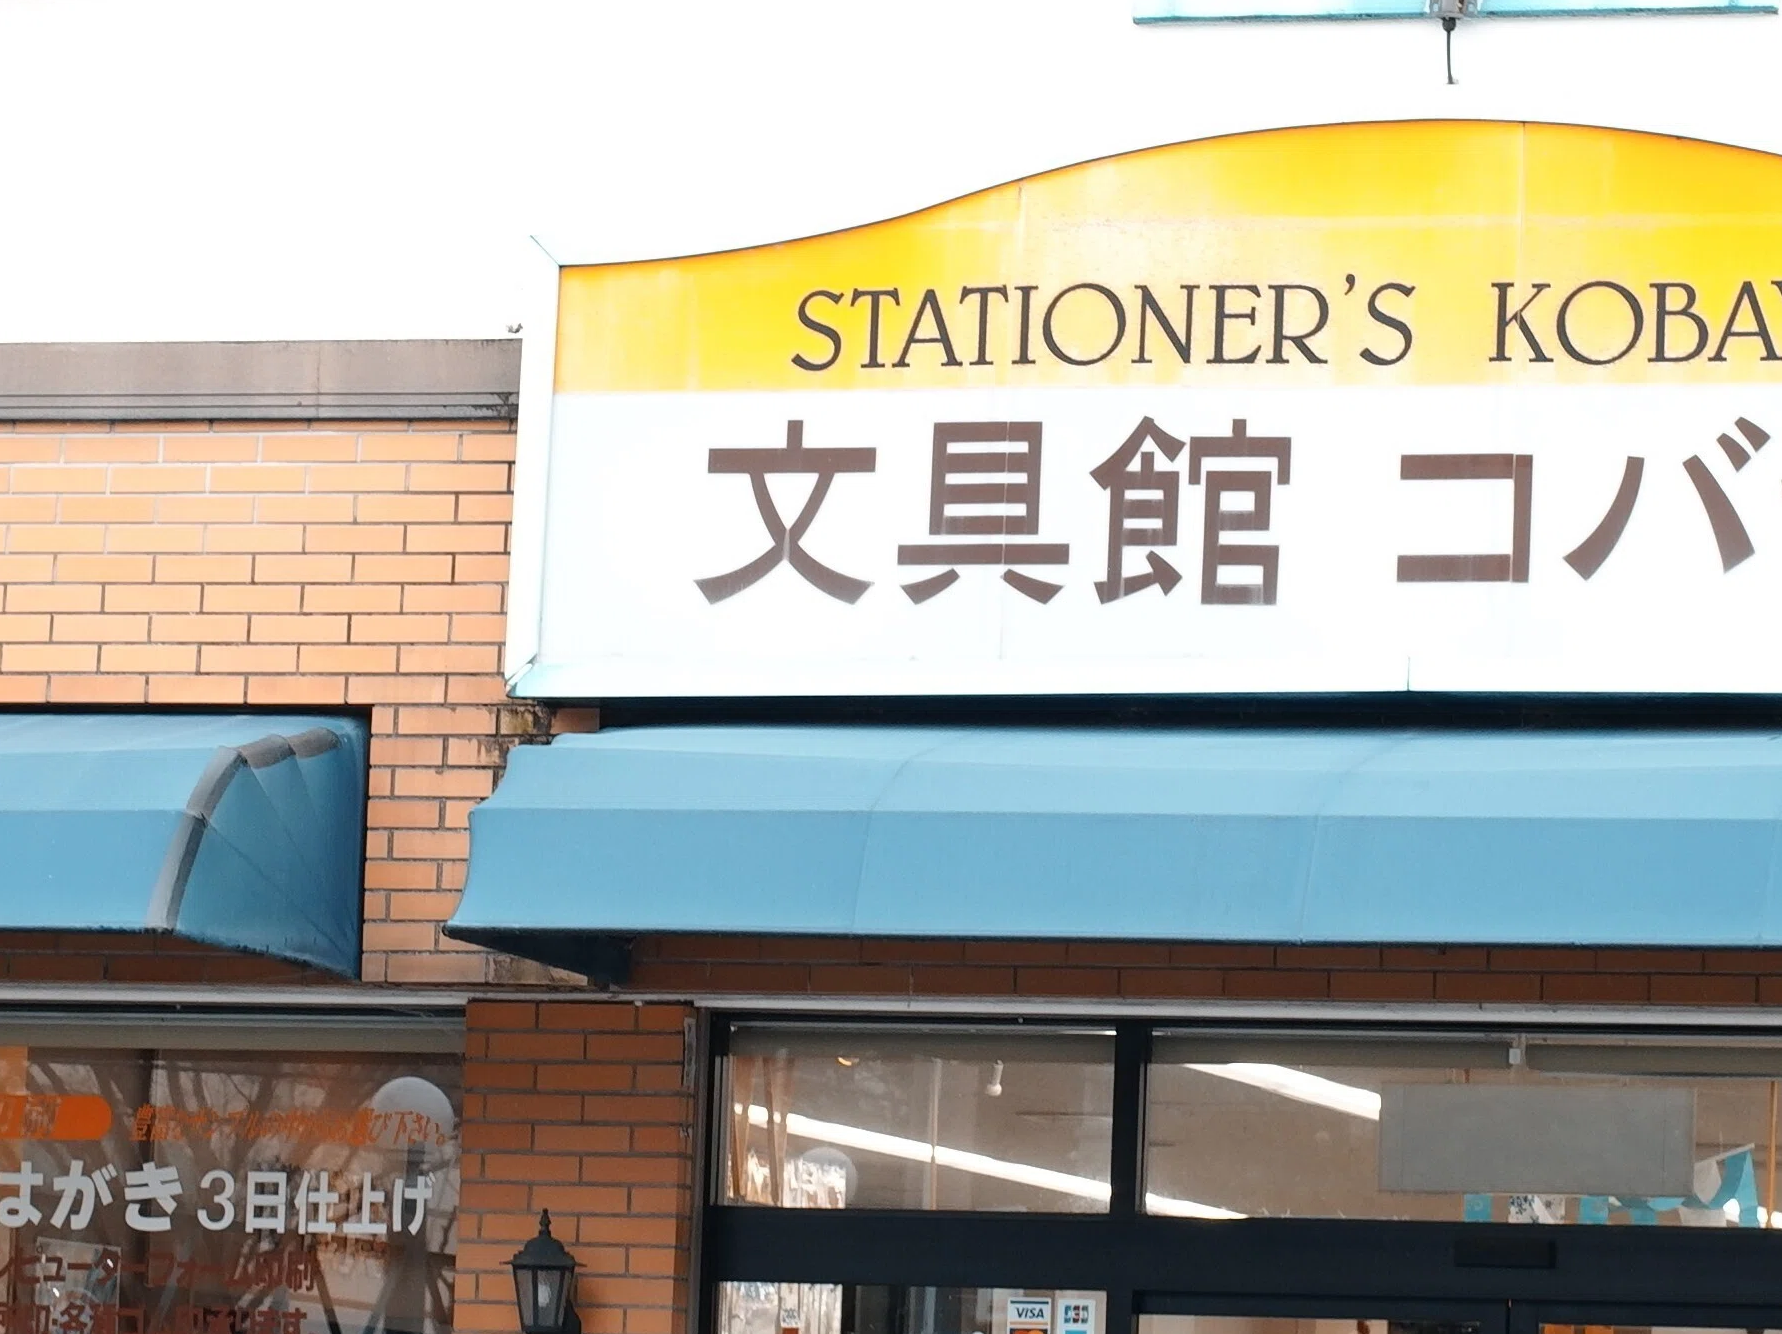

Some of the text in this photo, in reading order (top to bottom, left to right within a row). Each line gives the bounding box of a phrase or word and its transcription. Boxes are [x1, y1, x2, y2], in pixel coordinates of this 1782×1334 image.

[791, 273, 1416, 372] STATIONER'S
[694, 416, 1292, 606] 文具館
[197, 1169, 436, 1236] 3日仕上げ
[1016, 1307, 1045, 1319] VISA
